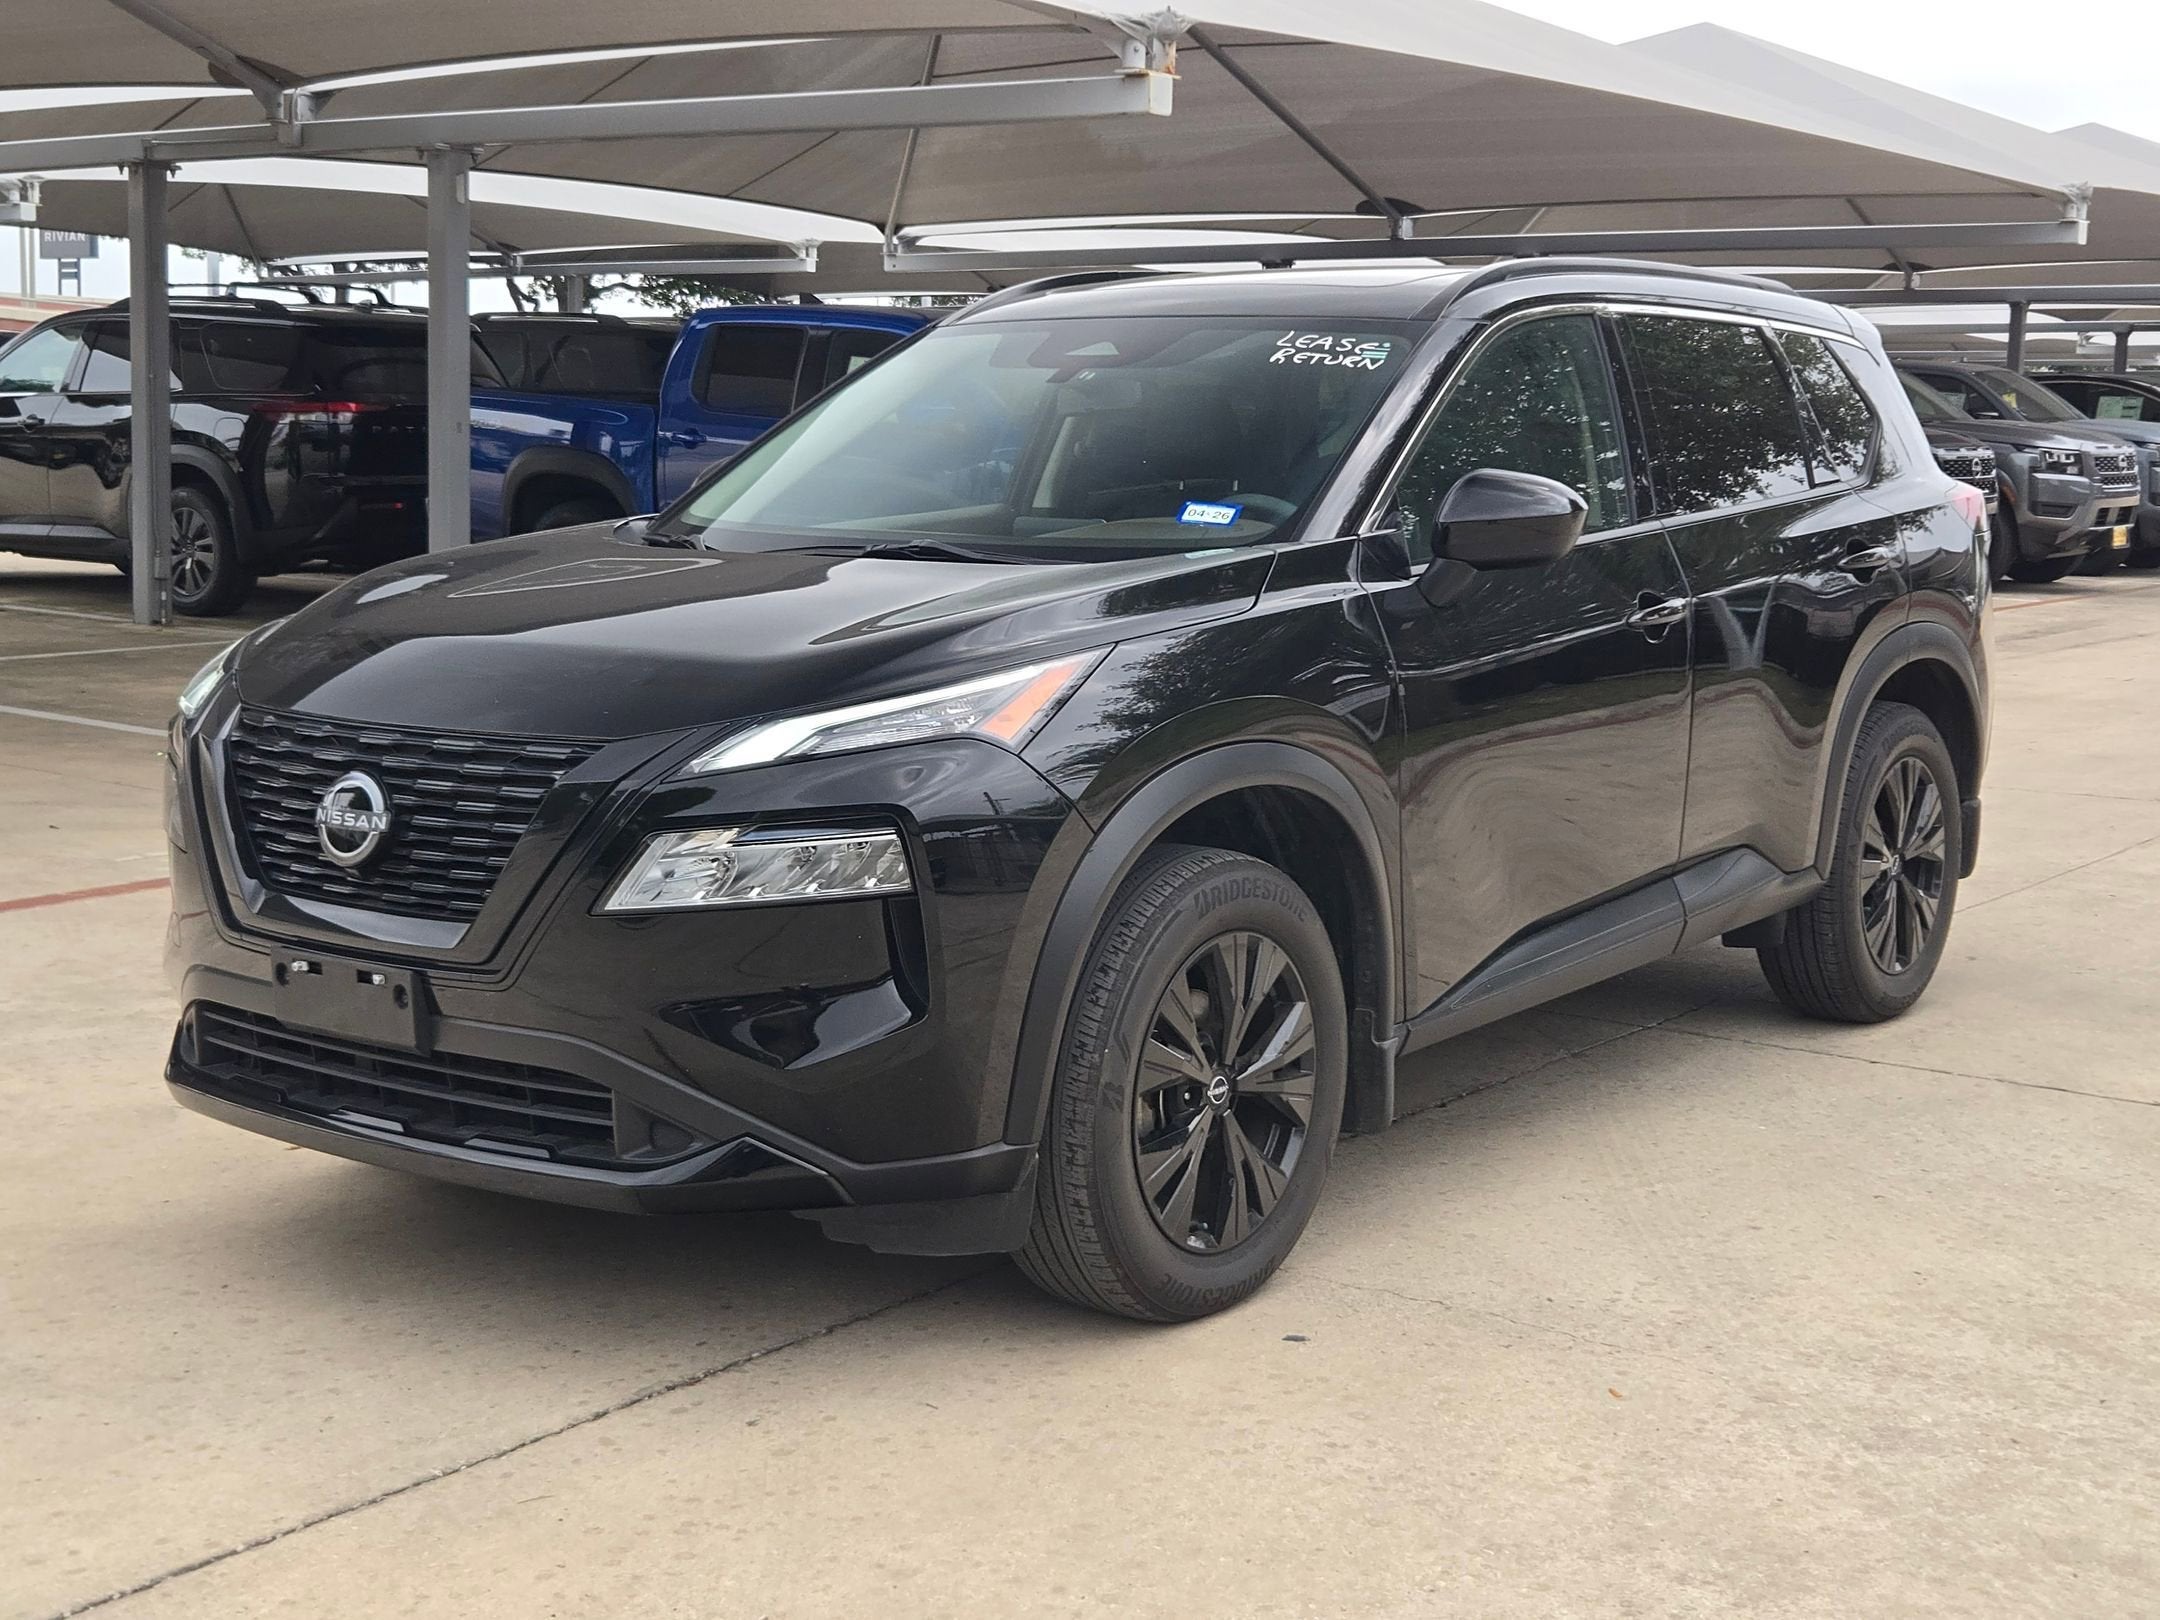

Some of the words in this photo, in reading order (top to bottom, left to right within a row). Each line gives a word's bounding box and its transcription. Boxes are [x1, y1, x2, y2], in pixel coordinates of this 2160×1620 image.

[44, 231, 86, 242] RIVIAN
[1276, 330, 1381, 354] LEASE
[1269, 348, 1385, 370] RETURN
[316, 807, 387, 830] NISSAN
[1194, 877, 1308, 922] BRIDGESTONE
